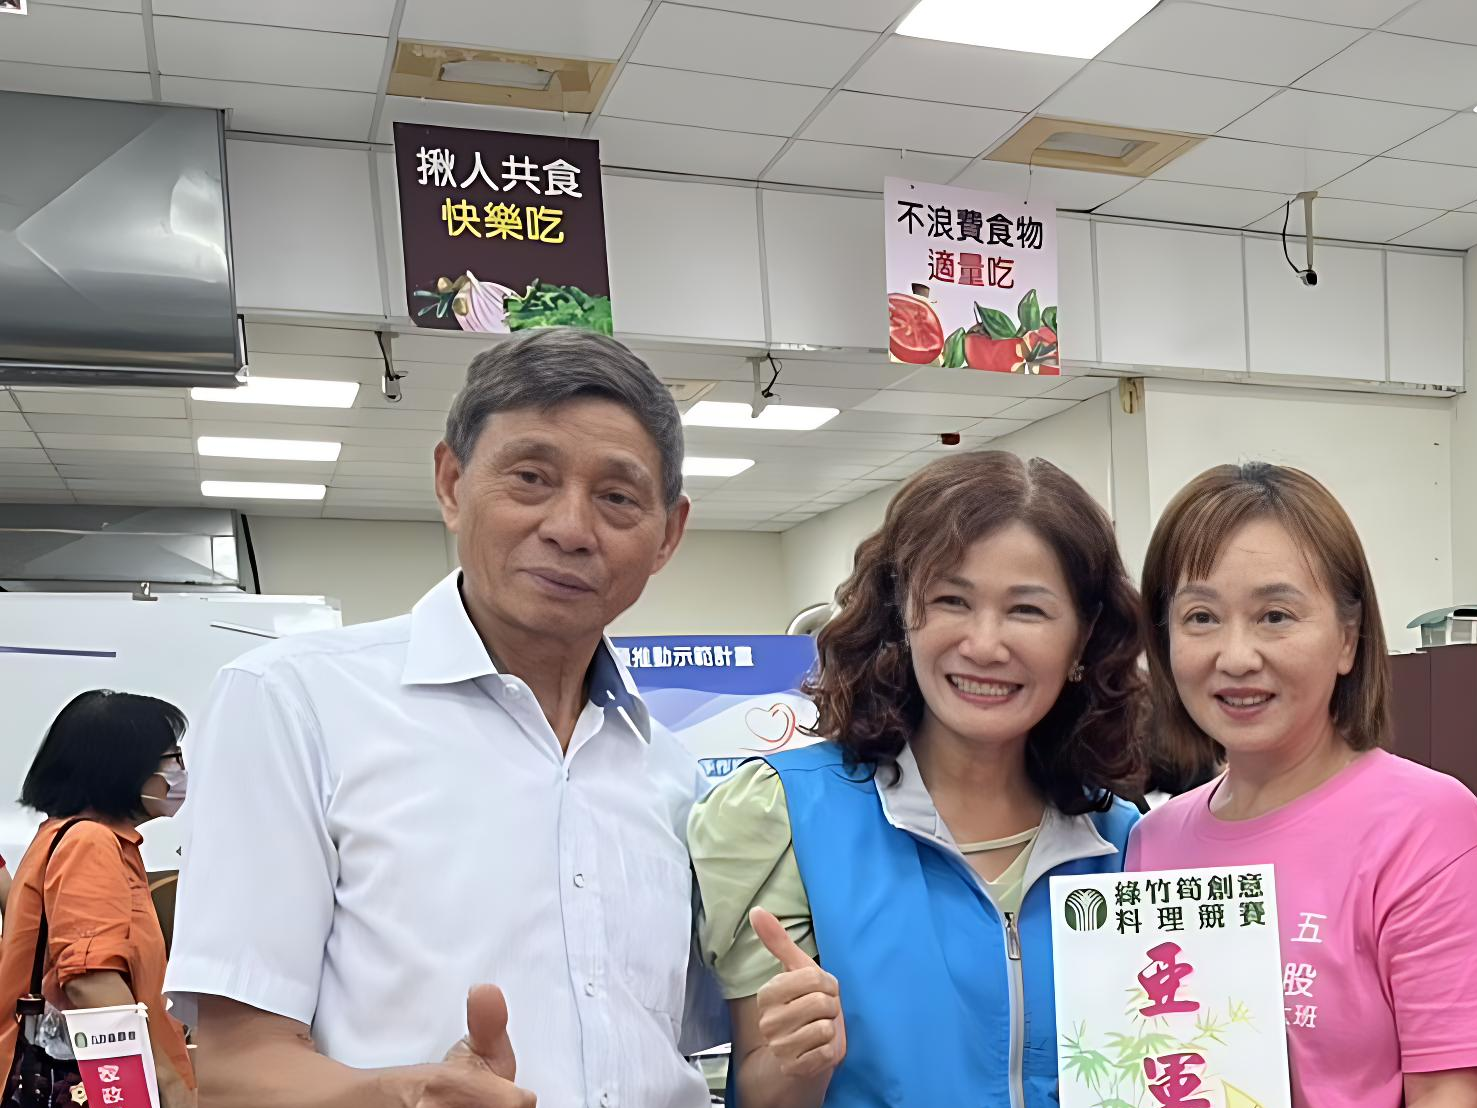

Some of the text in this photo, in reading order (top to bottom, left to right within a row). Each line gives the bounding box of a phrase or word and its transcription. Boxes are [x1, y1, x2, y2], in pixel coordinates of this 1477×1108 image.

[415, 146, 583, 198] 揪人共食
[441, 197, 565, 244] 快樂吃
[897, 200, 1043, 250] 不浪費食物
[927, 248, 1015, 289] 適量吃
[1114, 872, 1264, 906] 綠竹筍創意
[1115, 900, 1266, 935] 料理競賽
